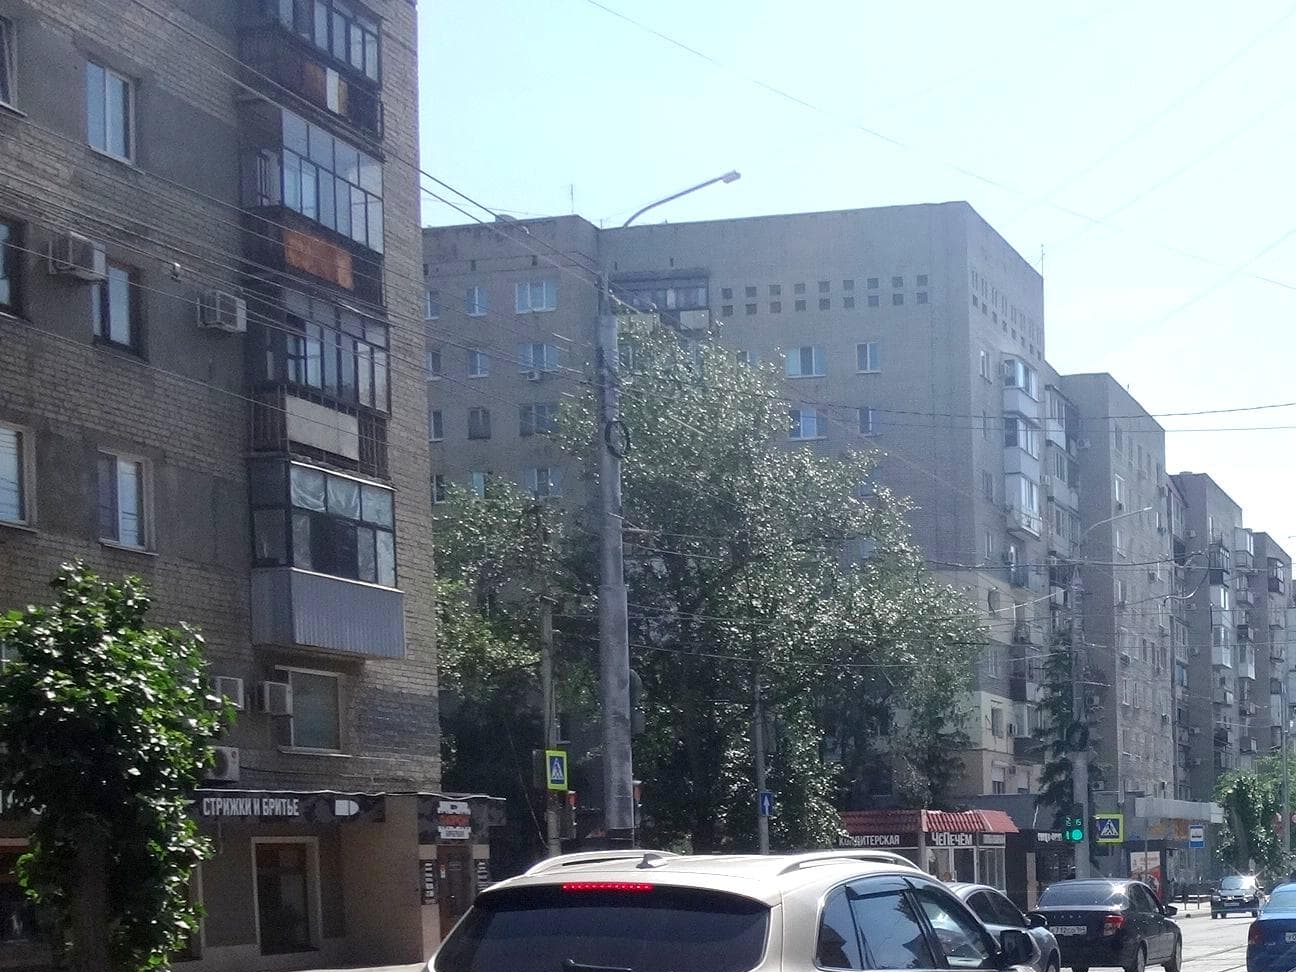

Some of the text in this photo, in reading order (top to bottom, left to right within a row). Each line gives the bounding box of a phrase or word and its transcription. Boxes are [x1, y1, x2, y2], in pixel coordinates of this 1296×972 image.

[203, 797, 299, 816] СТРИЖКИ И БРИТЬЕ
